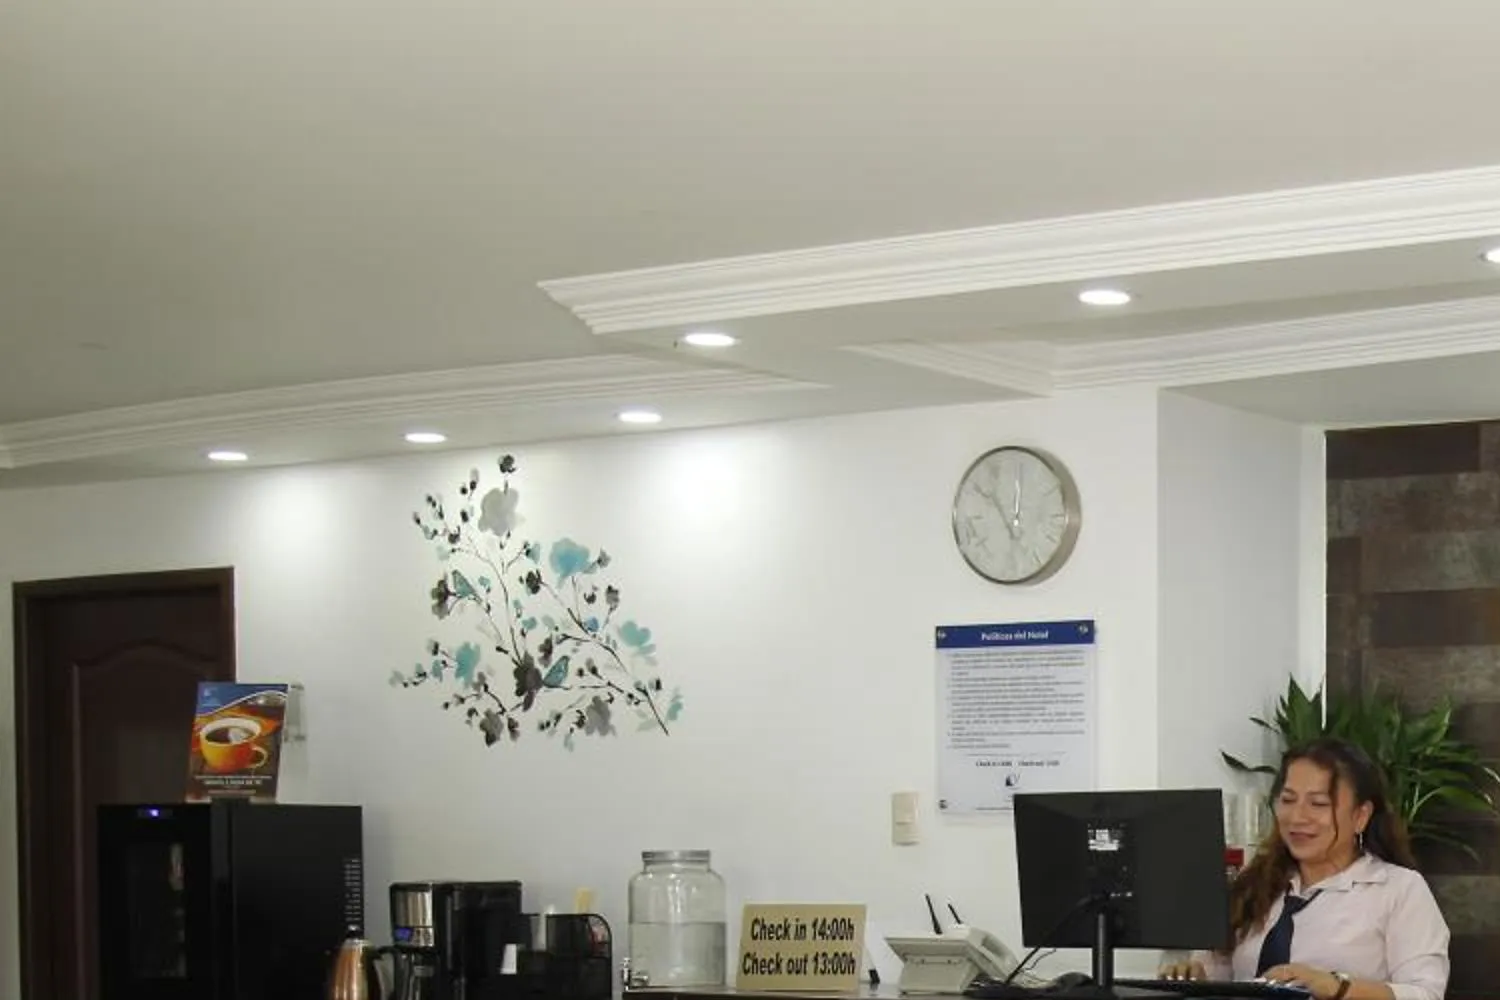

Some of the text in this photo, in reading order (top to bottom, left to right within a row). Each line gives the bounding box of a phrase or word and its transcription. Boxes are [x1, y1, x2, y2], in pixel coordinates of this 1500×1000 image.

[751, 917, 855, 941] Check in 14:00h
[742, 951, 856, 976] Check out 13:00h
